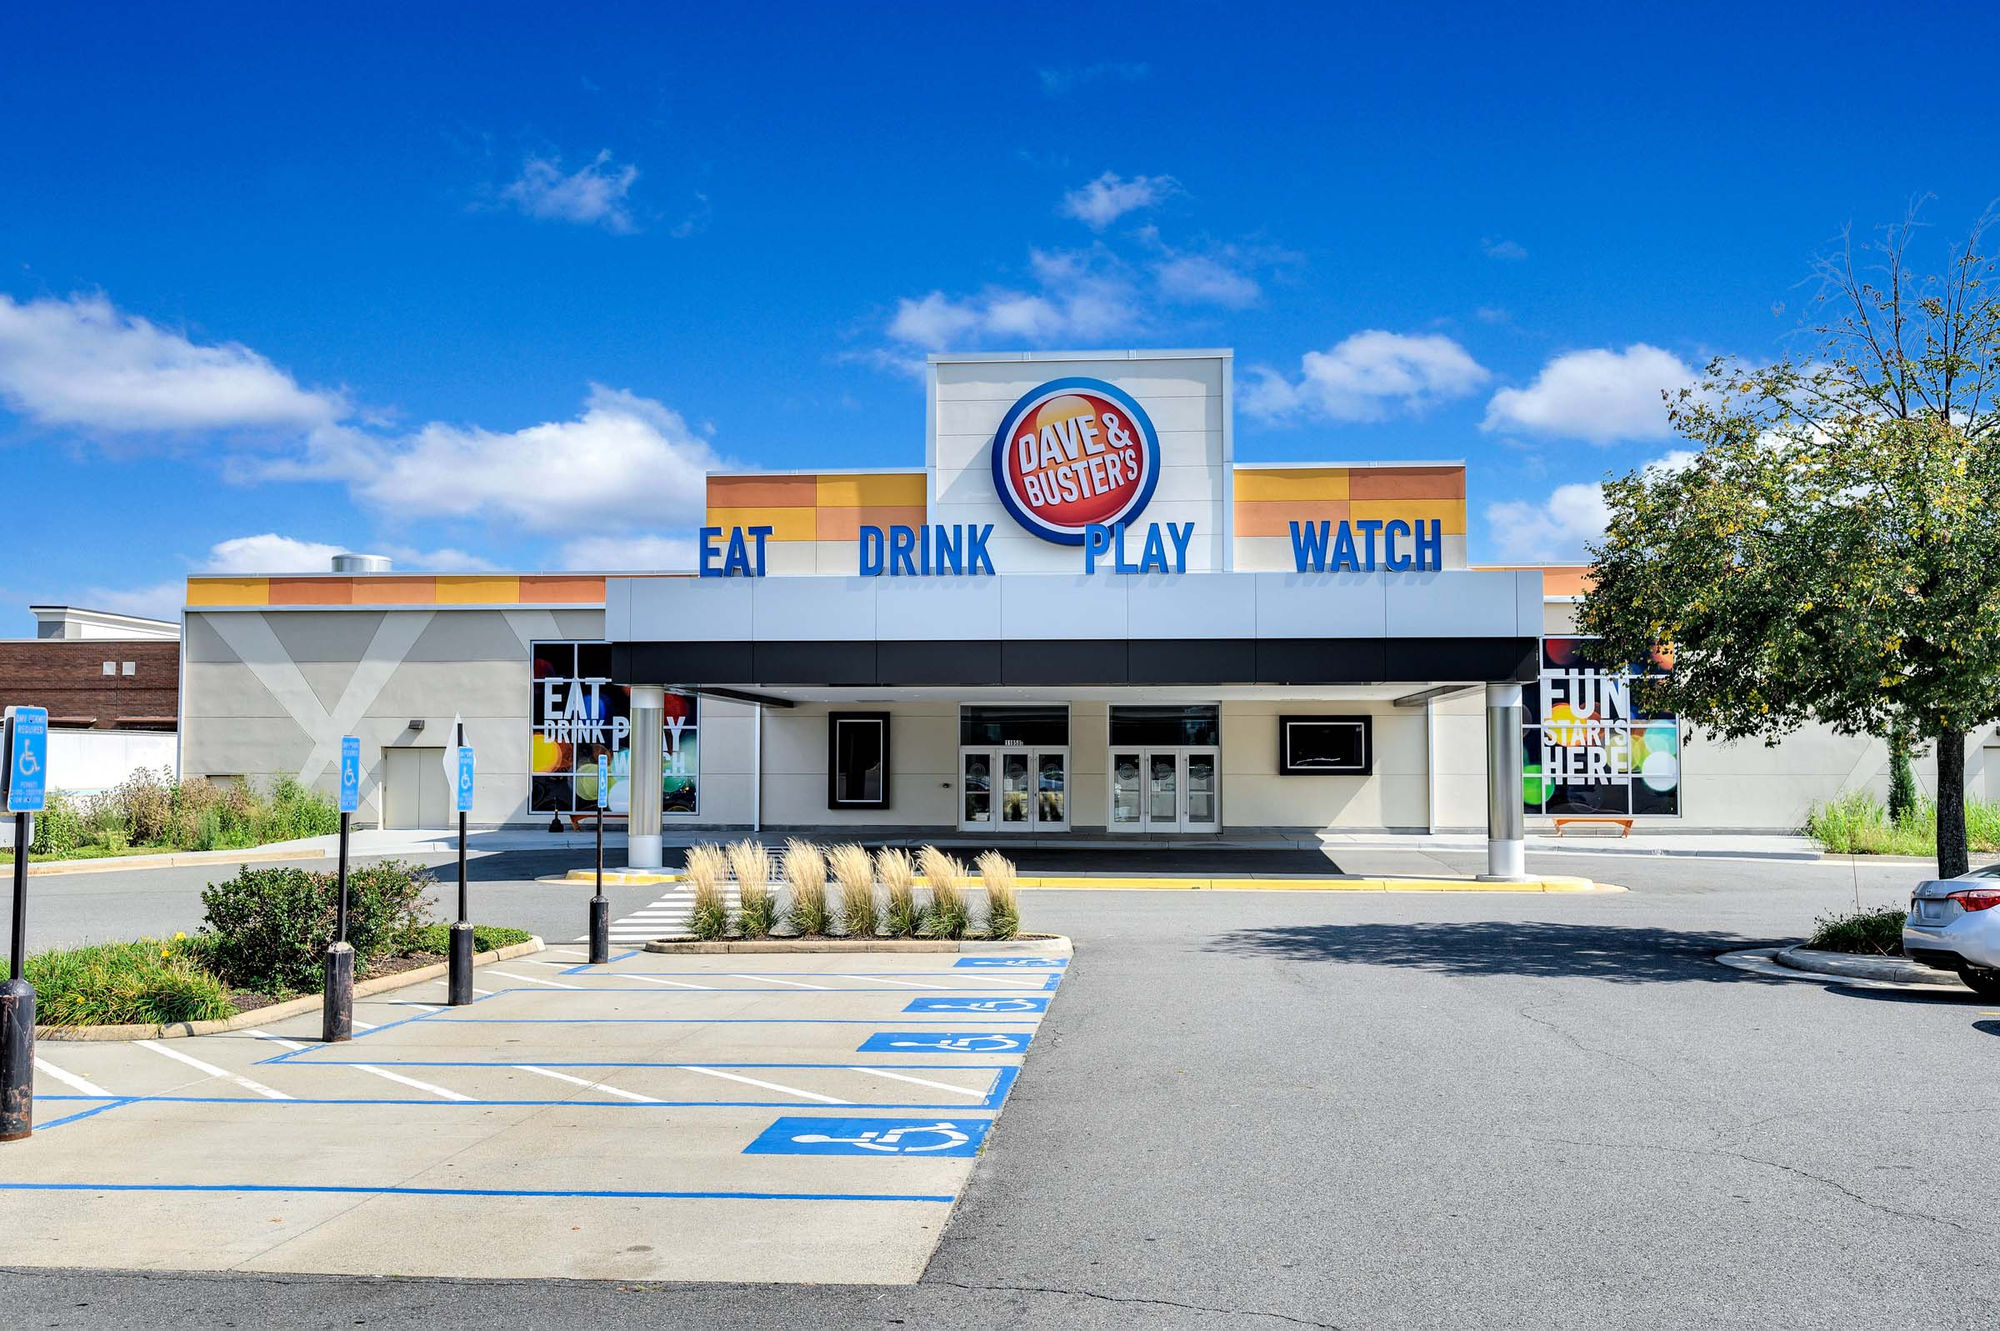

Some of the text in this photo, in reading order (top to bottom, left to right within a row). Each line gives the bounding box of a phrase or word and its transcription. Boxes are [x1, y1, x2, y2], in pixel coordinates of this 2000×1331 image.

[1018, 412, 1133, 474] DAVE &
[1023, 448, 1138, 507] BUSTER'S
[700, 518, 1442, 577] EAT DRINK PLAY WATCH
[544, 677, 606, 720] EAT
[1543, 668, 1630, 719] FUN
[543, 719, 606, 744] DRINK
[612, 716, 686, 752] PY
[1543, 719, 1628, 746] STARTS
[1543, 746, 1630, 785] HERE
